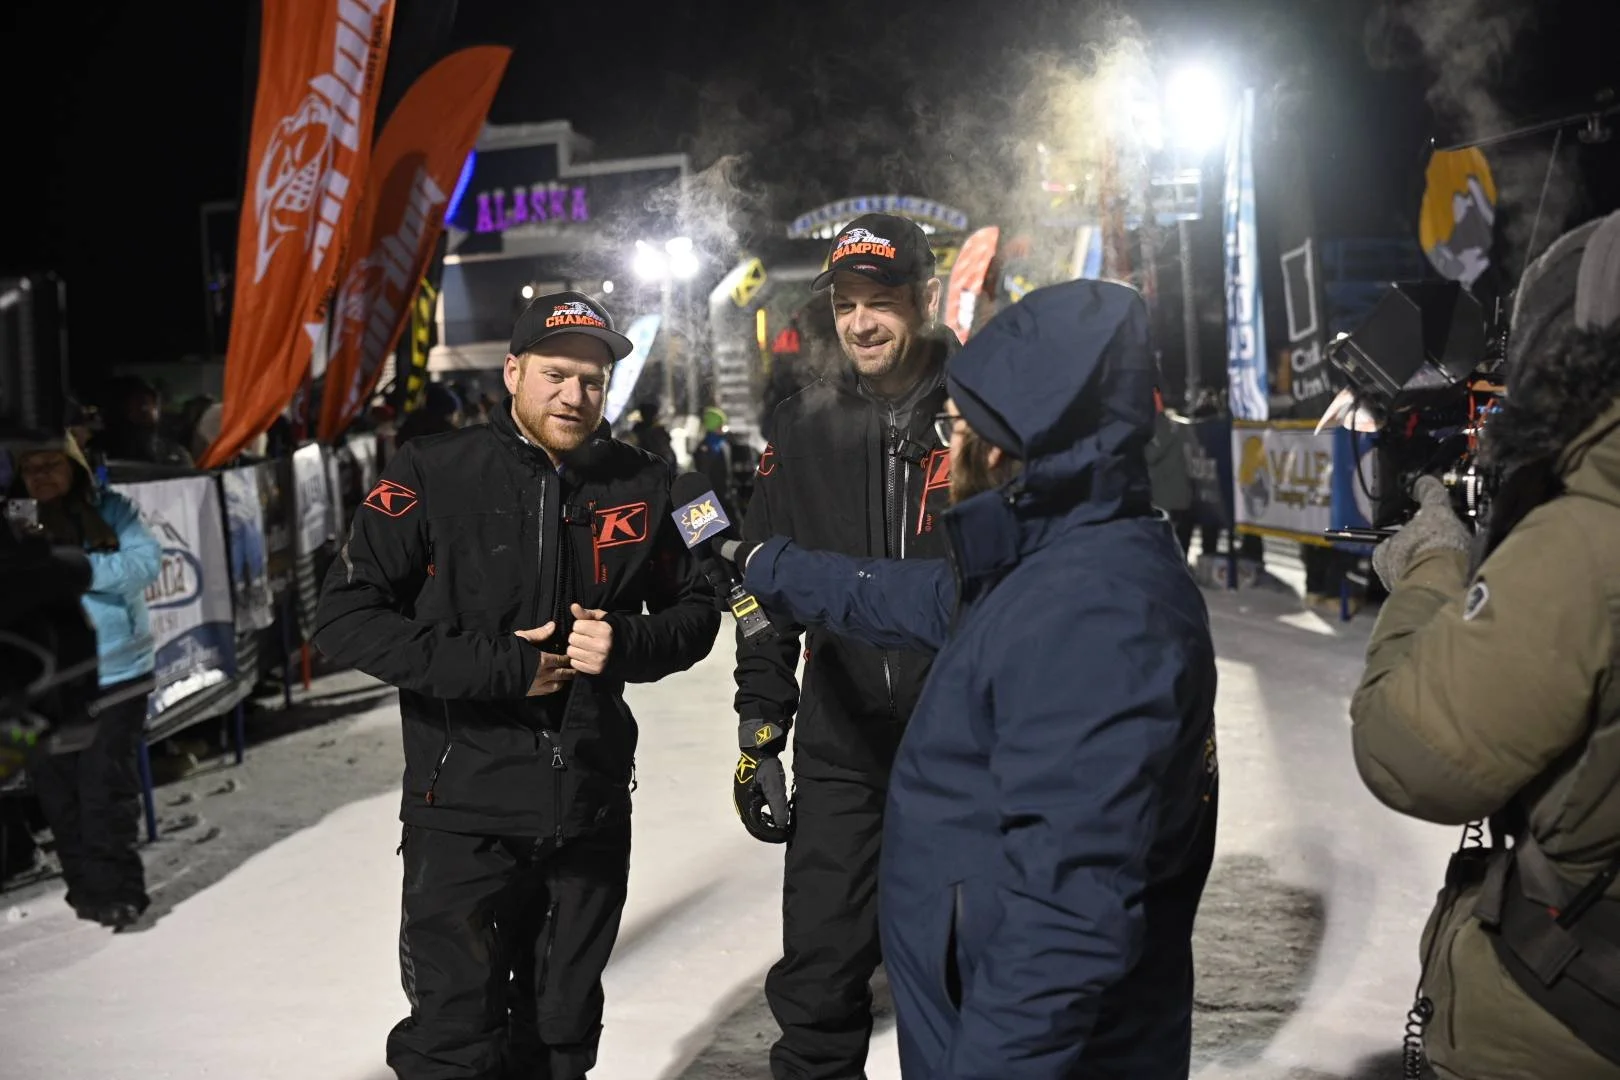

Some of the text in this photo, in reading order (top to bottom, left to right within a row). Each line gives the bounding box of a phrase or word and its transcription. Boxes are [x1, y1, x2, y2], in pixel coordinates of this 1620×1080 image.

[475, 183, 588, 233] ALASKA
[832, 243, 896, 262] CHAMPION
[690, 499, 717, 524] AK
